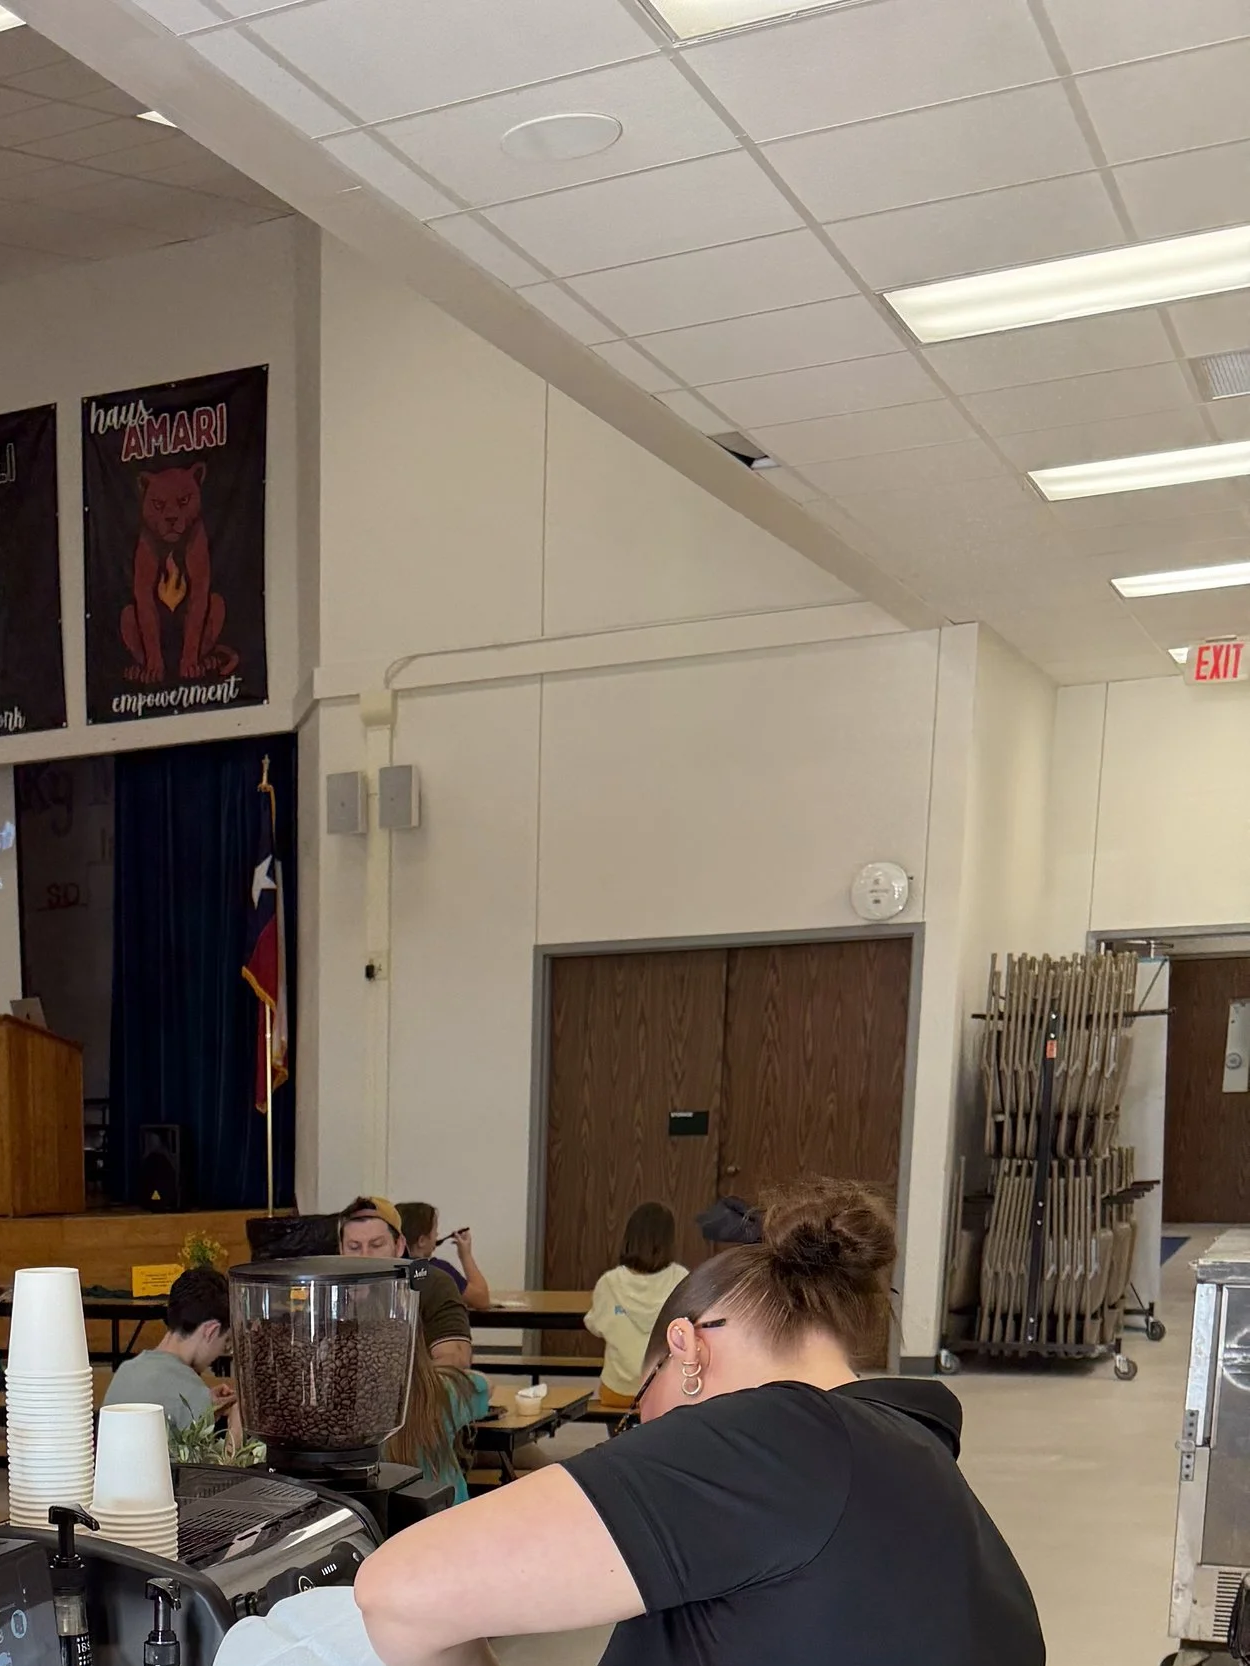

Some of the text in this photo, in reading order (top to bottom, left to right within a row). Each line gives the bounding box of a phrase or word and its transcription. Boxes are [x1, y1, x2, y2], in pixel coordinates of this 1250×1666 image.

[89, 399, 152, 435] haus
[120, 402, 227, 463] AMARI
[1195, 643, 1244, 680] EXIT
[112, 674, 241, 714] empowerment
